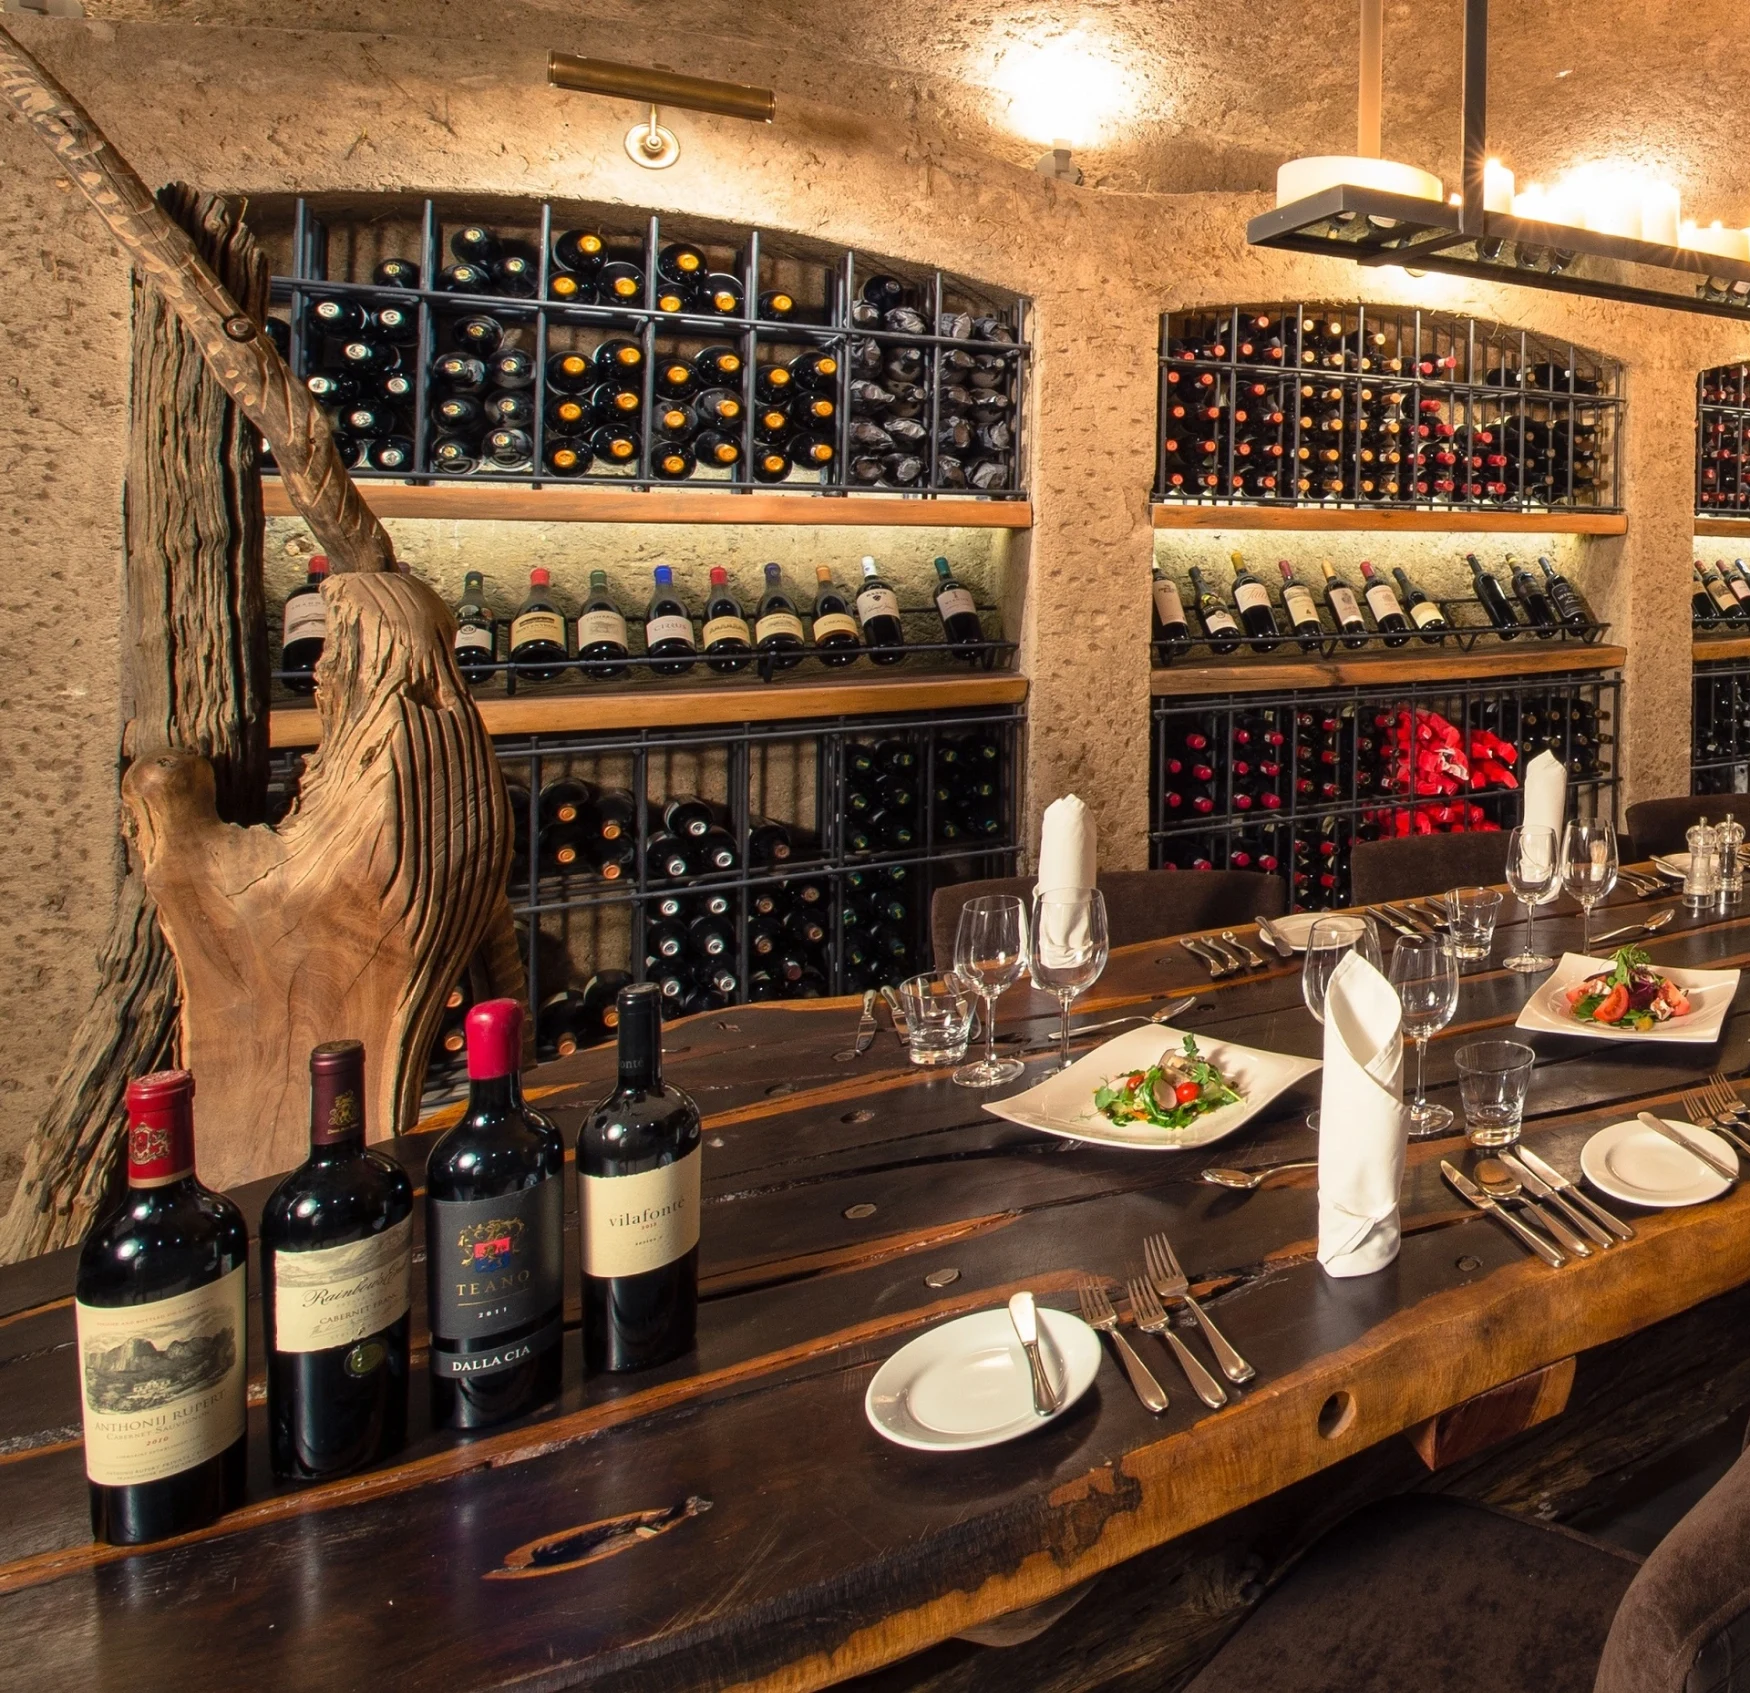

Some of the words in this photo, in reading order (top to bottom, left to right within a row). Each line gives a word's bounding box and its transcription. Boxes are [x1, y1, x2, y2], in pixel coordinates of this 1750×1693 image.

[456, 1269, 530, 1296] TEANO
[319, 1303, 371, 1325] CABERNET
[478, 1306, 508, 1319] 2011
[452, 1356, 501, 1372] DALLA
[504, 1345, 531, 1363] CIA
[94, 1414, 166, 1432] ANTHONIJ
[172, 1389, 226, 1421] RUPERT
[106, 1431, 151, 1441] CABERNET
[155, 1411, 210, 1434] SAUVIGNON
[146, 1436, 169, 1447] 2010
